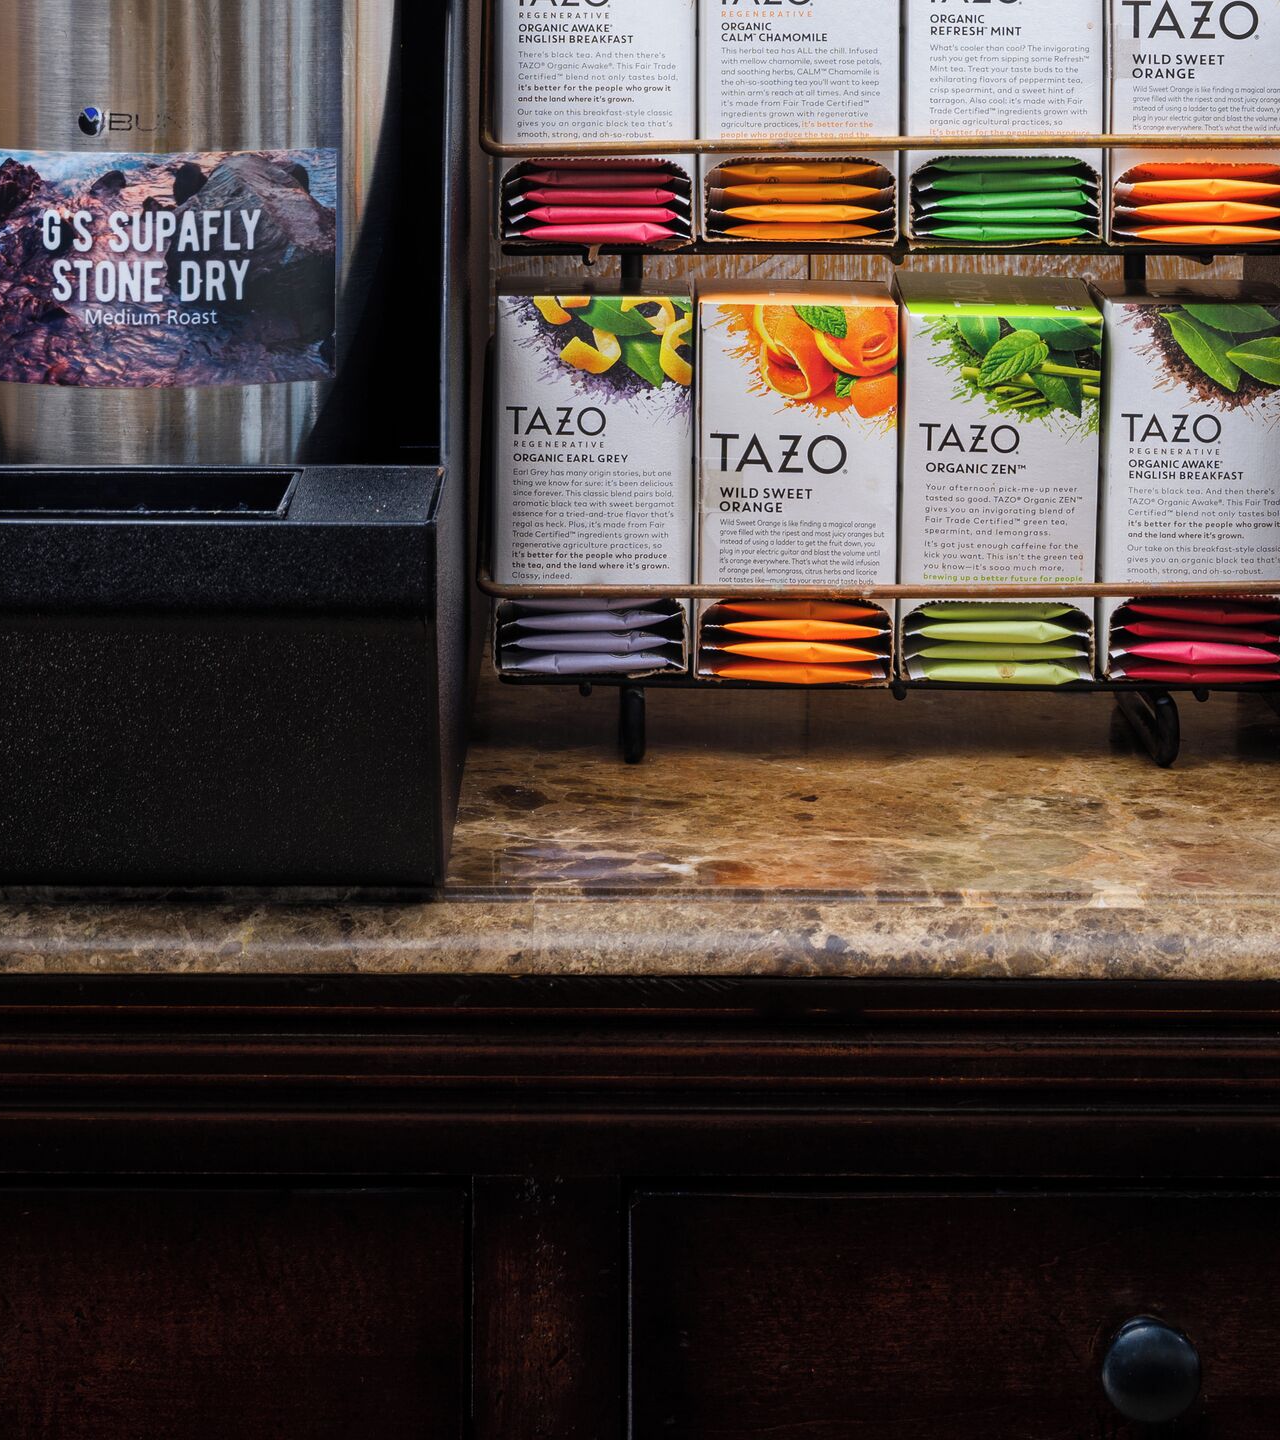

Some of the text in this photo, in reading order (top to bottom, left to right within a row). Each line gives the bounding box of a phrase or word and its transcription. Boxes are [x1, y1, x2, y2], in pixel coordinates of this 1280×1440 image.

[930, 14, 985, 23] ORGANIC
[1122, 0, 1259, 40] TAZO
[519, 24, 569, 32] ORGANIC
[721, 23, 771, 31] ORGANIC
[991, 27, 1021, 36] MINT
[519, 35, 633, 44] ENGLISH BREAKFAST
[759, 33, 827, 42] CHAMOMILE
[1132, 54, 1224, 65] WILD SWEET
[1132, 68, 1195, 79] ORANGE
[595, 85, 623, 94] people
[608, 97, 634, 105] grown.
[42, 209, 261, 252] G'S SUPAFLY
[52, 259, 250, 302] STONE DRY
[85, 309, 217, 325] Medium Roast
[506, 406, 606, 436] TAZO
[1121, 414, 1221, 443] TAZO
[919, 423, 1020, 454] TAZO
[513, 454, 628, 463] ORGANIC EARL GREY
[710, 433, 847, 474] TAZO
[926, 462, 988, 474] ORGANIC
[1129, 460, 1179, 468] ORGANIC
[1129, 471, 1243, 480] ENGLISH BREAKFAST
[720, 487, 812, 499] WILD SWEET
[949, 484, 995, 492] afternoon
[998, 486, 1050, 495] pick-me-up
[720, 501, 783, 513] ORANGE
[585, 552, 613, 561] people
[634, 552, 667, 561] produce
[641, 564, 669, 572] grown.
